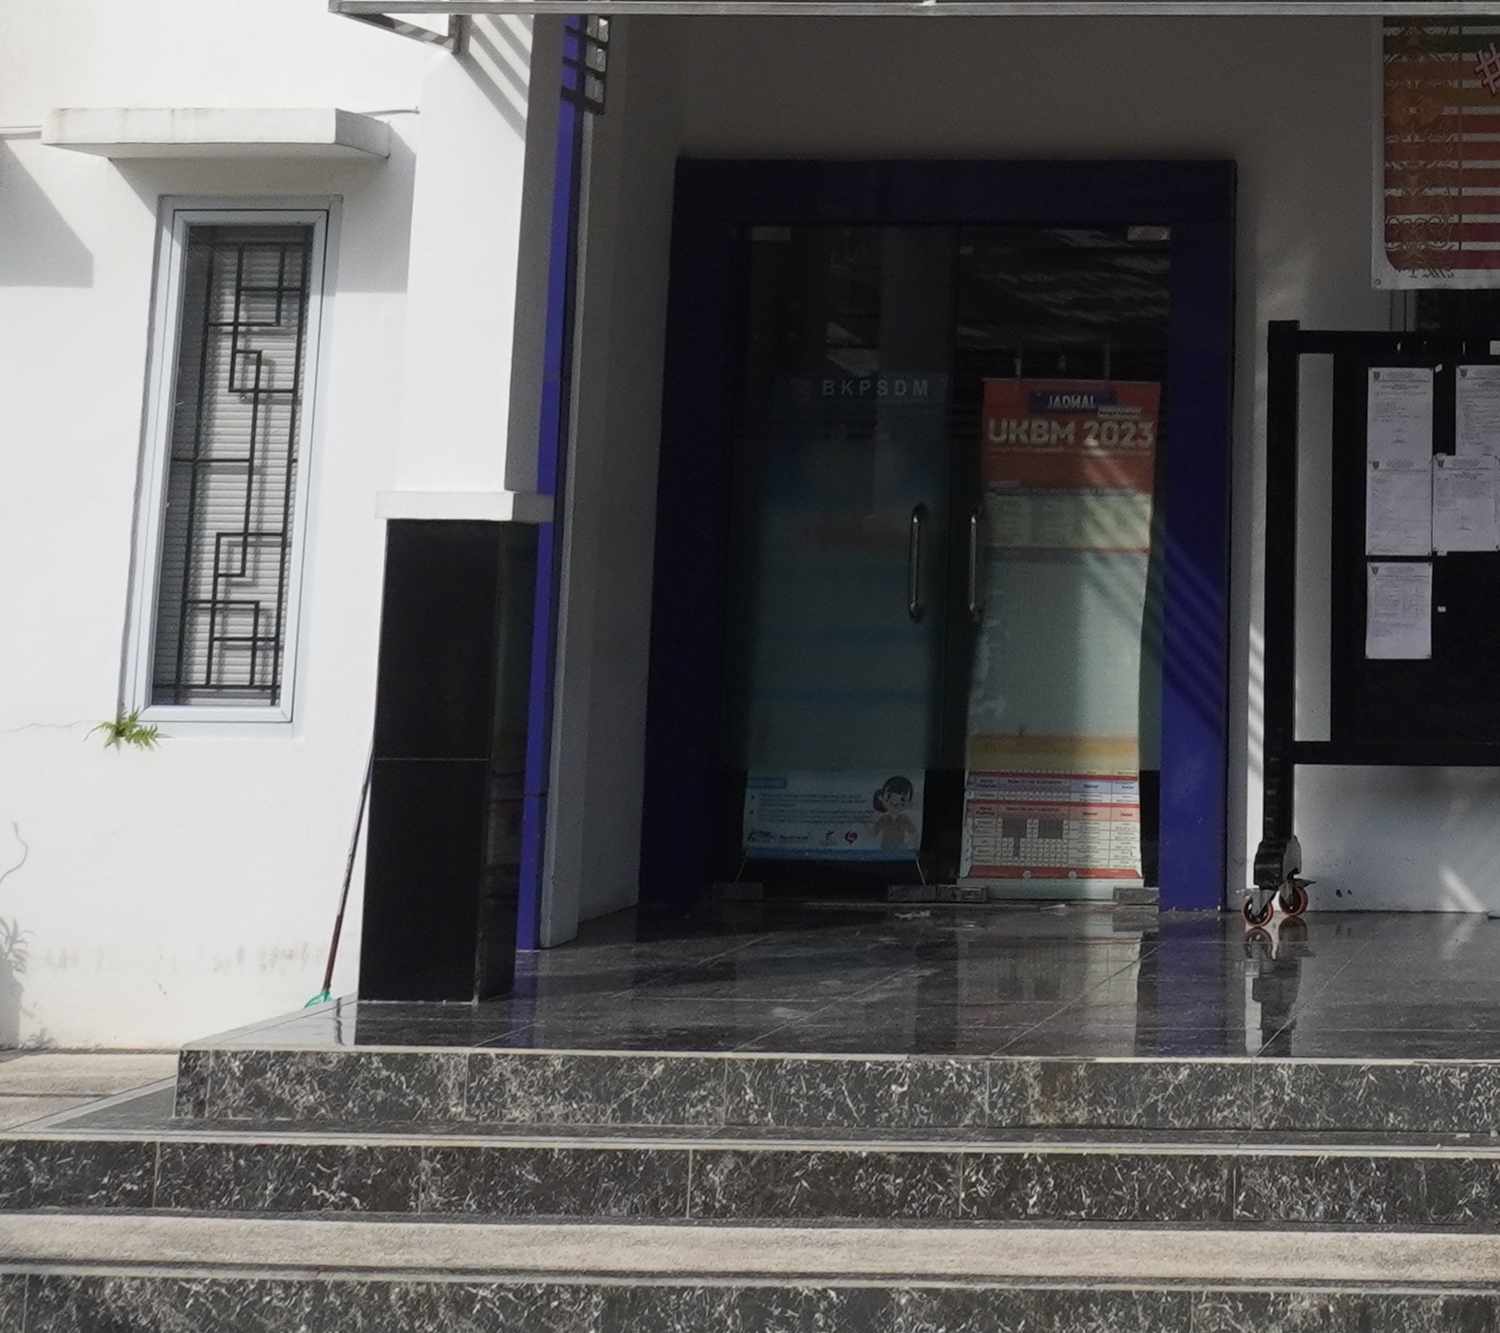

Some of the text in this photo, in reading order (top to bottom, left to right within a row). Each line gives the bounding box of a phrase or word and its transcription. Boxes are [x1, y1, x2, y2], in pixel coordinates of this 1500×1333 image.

[821, 379, 928, 397] BKPSDM
[1047, 394, 1096, 410] JADWAL
[988, 418, 1154, 448] UKBM 2023
